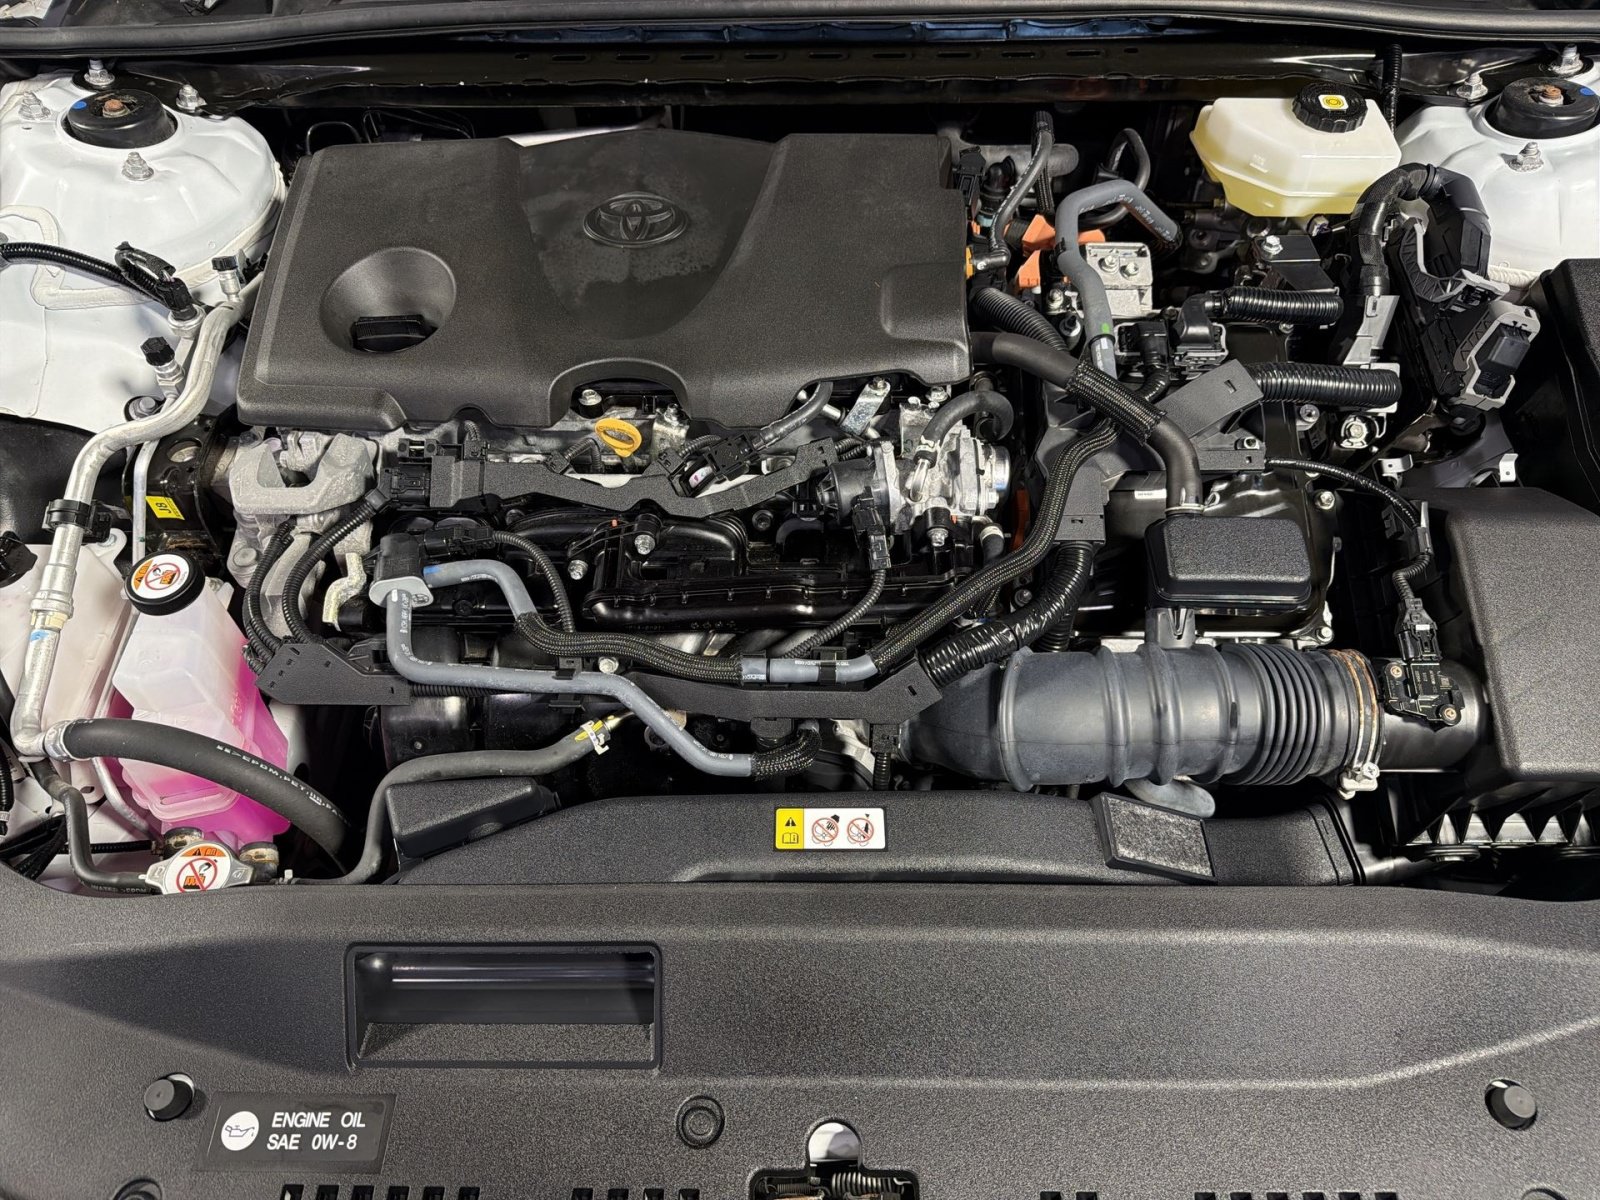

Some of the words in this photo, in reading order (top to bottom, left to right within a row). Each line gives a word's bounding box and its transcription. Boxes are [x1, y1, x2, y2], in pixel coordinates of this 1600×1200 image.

[272, 1112, 331, 1128] ENGINE
[341, 1112, 365, 1128] OIL
[267, 1134, 301, 1150] SAE
[312, 1134, 357, 1150] 0W-8
